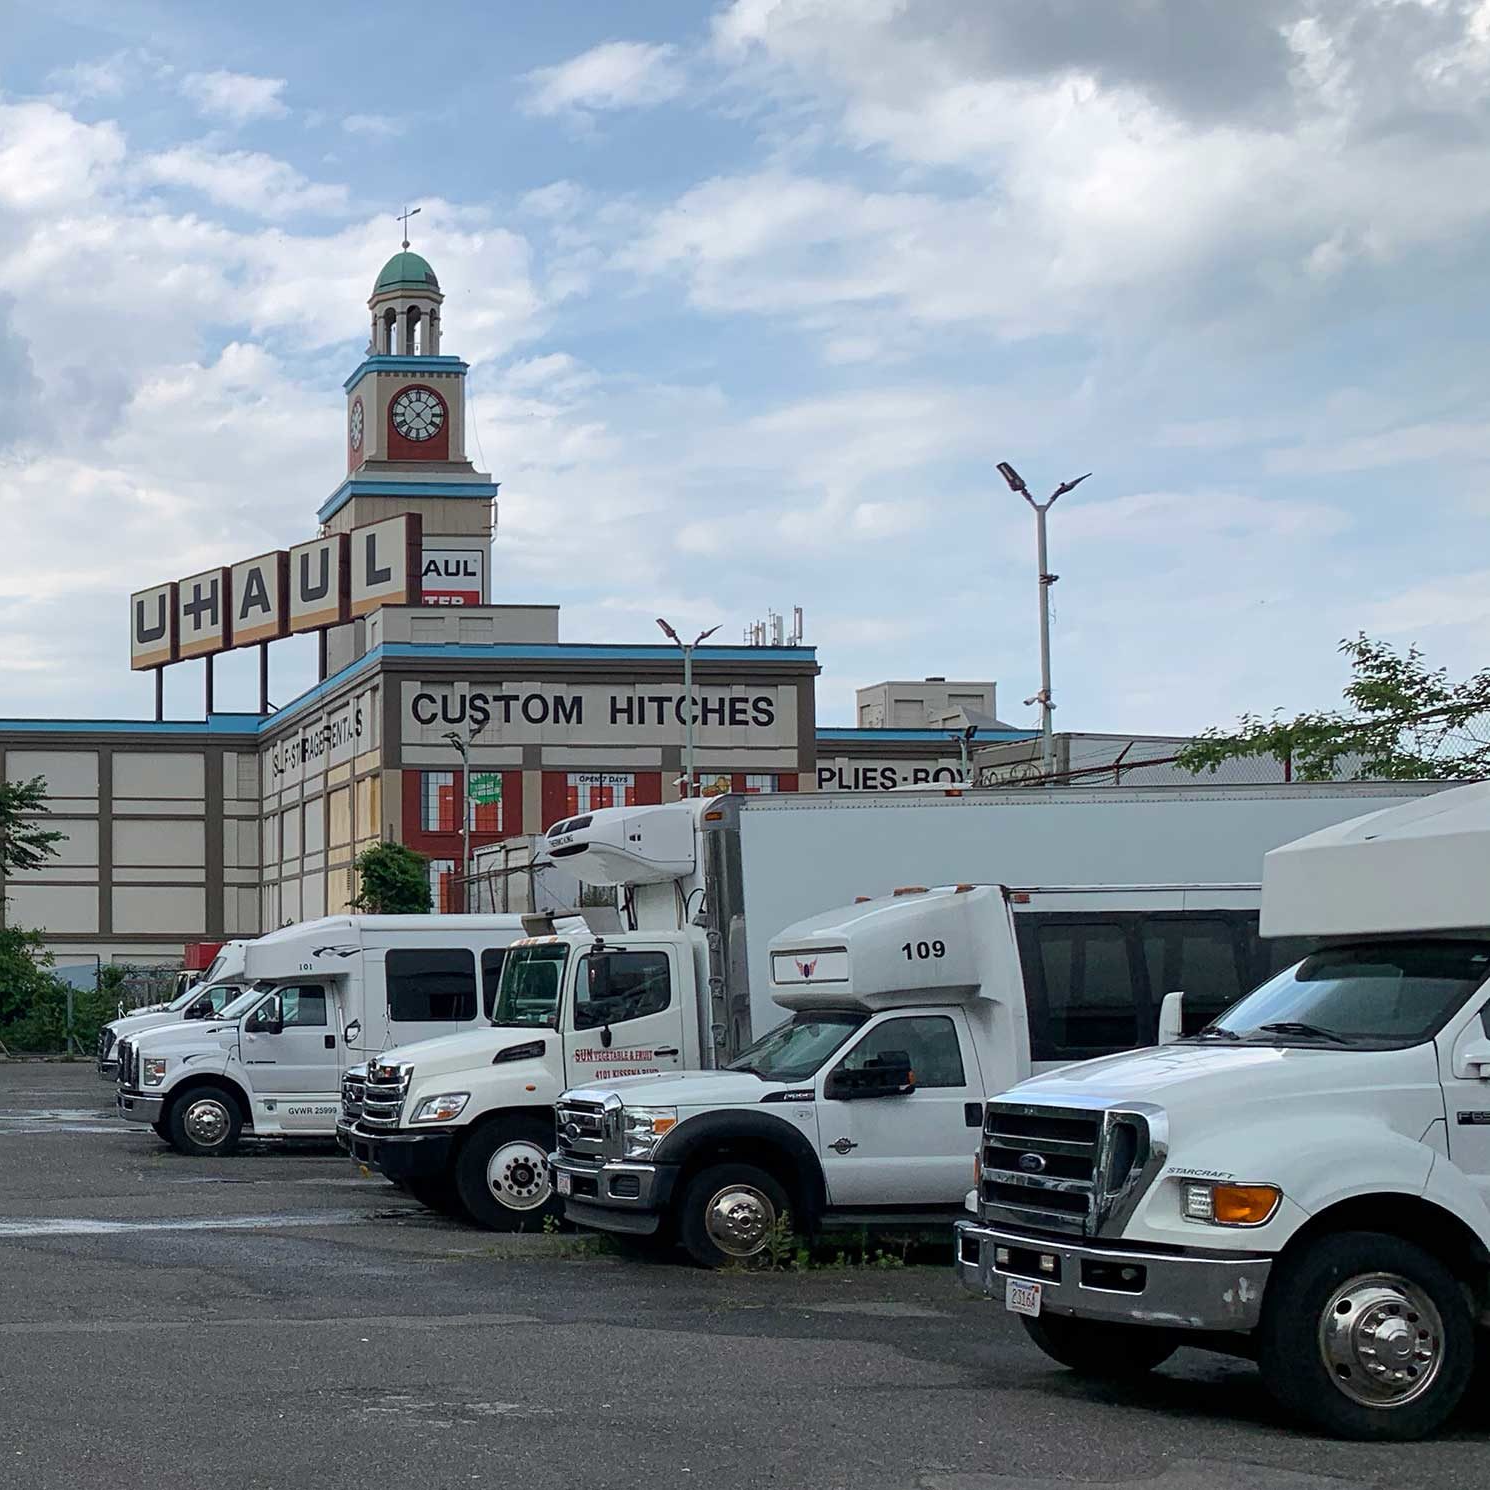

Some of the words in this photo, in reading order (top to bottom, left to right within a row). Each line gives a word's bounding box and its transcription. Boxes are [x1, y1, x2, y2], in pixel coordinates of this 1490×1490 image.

[411, 693, 583, 725] CUSTOM
[610, 695, 775, 727] HITCHES
[579, 775, 600, 783] OPEN
[901, 940, 946, 961] 109
[299, 963, 312, 971] 101
[574, 1048, 593, 1062] SUN
[593, 1050, 628, 1062] VEGETABLE
[635, 1050, 653, 1061] FRUIT
[288, 1107, 313, 1115] GVWR
[1167, 1166, 1237, 1179] STARCRAFT
